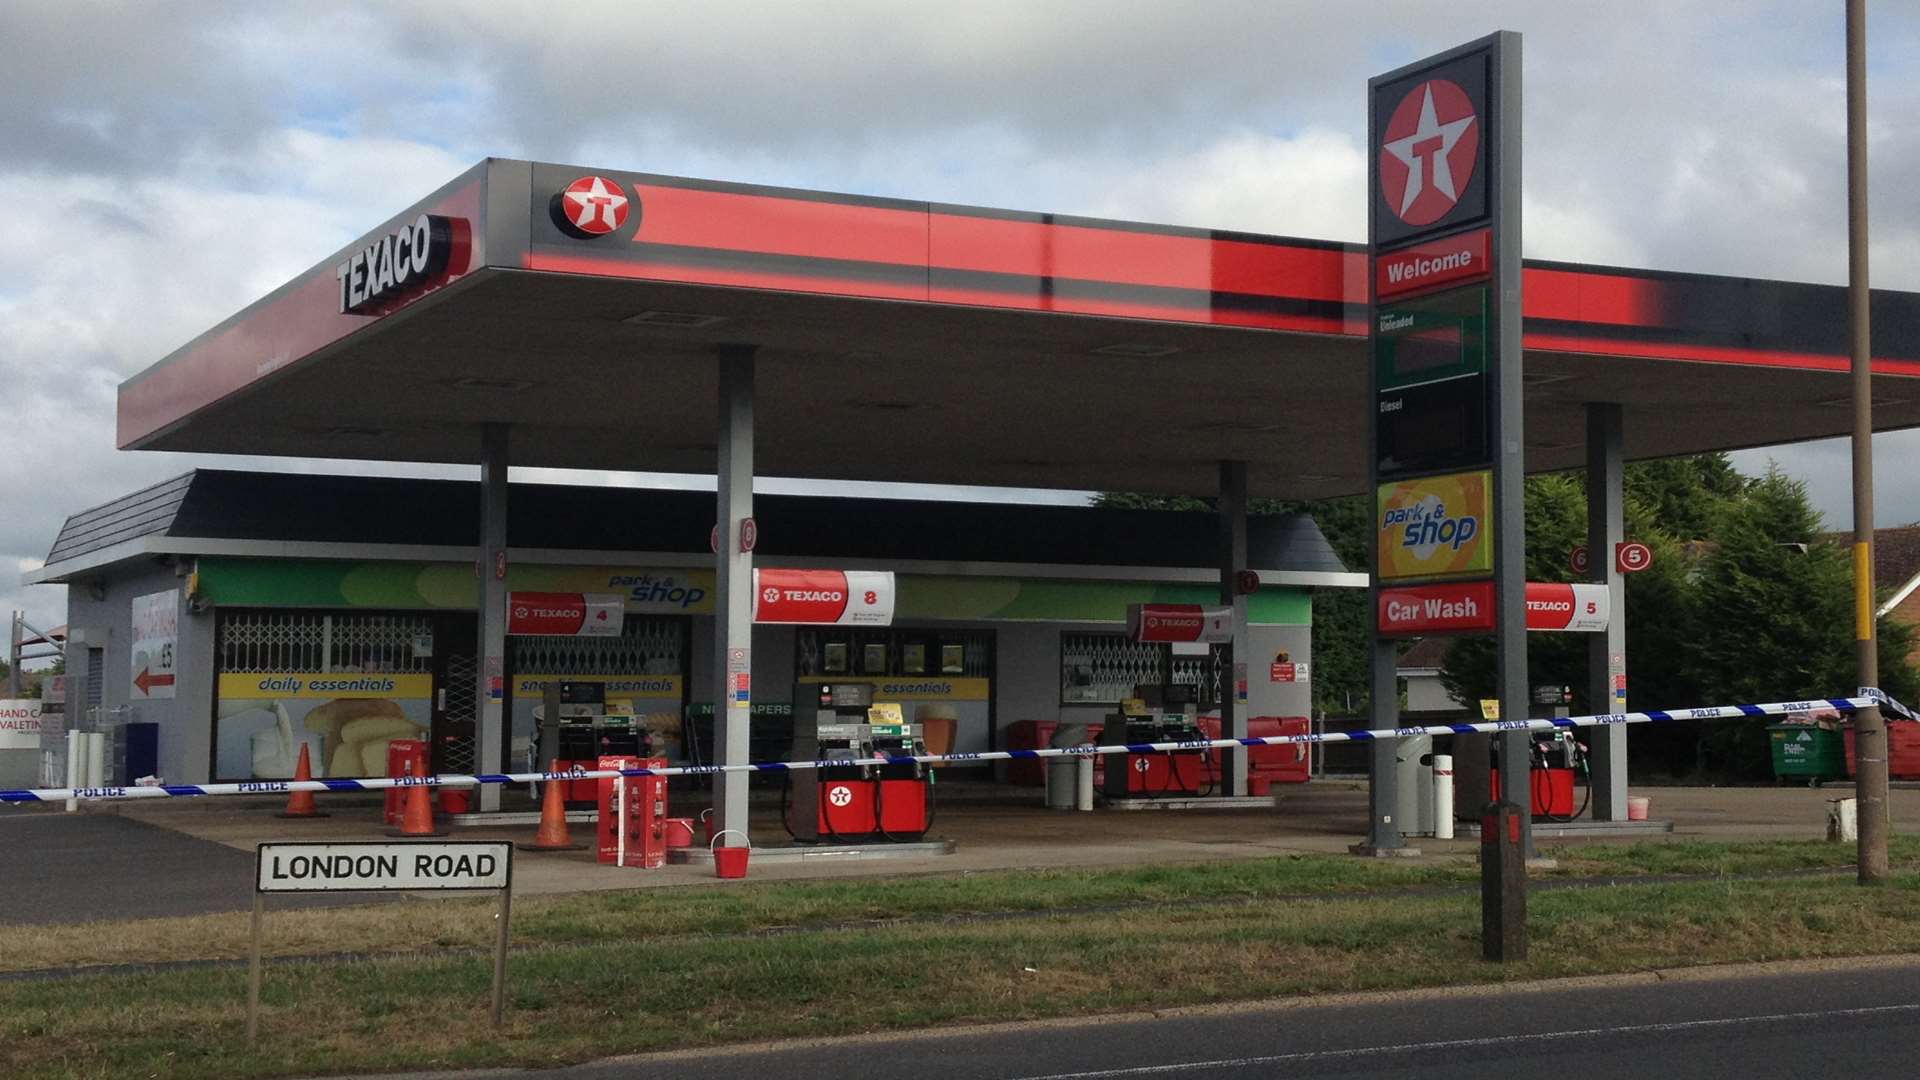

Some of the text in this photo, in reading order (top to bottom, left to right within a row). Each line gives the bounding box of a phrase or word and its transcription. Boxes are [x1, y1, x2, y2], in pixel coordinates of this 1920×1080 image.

[336, 214, 430, 313] TEXACO
[1388, 250, 1471, 284] Welcome
[1380, 314, 1414, 332] Unleaded
[1380, 398, 1402, 413] Diesel
[1384, 504, 1444, 528] park &
[1403, 513, 1476, 550] shop
[1577, 552, 1586, 565] 6
[1628, 550, 1641, 563] 5
[608, 575, 673, 588] park &
[630, 581, 704, 608] shop
[784, 590, 842, 601] TEXACO
[864, 591, 877, 605] 8
[532, 608, 580, 618] TEXACO
[1388, 597, 1476, 621] Car Wash
[1526, 601, 1570, 612] TEXACO
[1587, 603, 1596, 614] 5
[596, 610, 607, 621] 4
[1161, 619, 1199, 627] TEXACO
[1213, 620, 1220, 629] 1
[162, 643, 172, 668] £5
[258, 677, 395, 693] daily essentials
[604, 679, 673, 691] ssentials
[883, 682, 952, 694] essentials
[73, 787, 126, 797] POLICE
[238, 782, 288, 792] POLICE
[394, 776, 442, 786] POLICE
[542, 769, 588, 780] POLICE
[1061, 745, 1099, 754] POLICE
[1177, 741, 1212, 749] POLICE
[1288, 734, 1323, 742] POLICE
[1394, 727, 1428, 736] POLICE
[1497, 720, 1529, 730] POLICE
[1595, 714, 1626, 724] POLICE
[1690, 708, 1721, 718] POLICE
[1782, 702, 1811, 712] POLICE
[273, 854, 495, 879] LONDON ROAD
